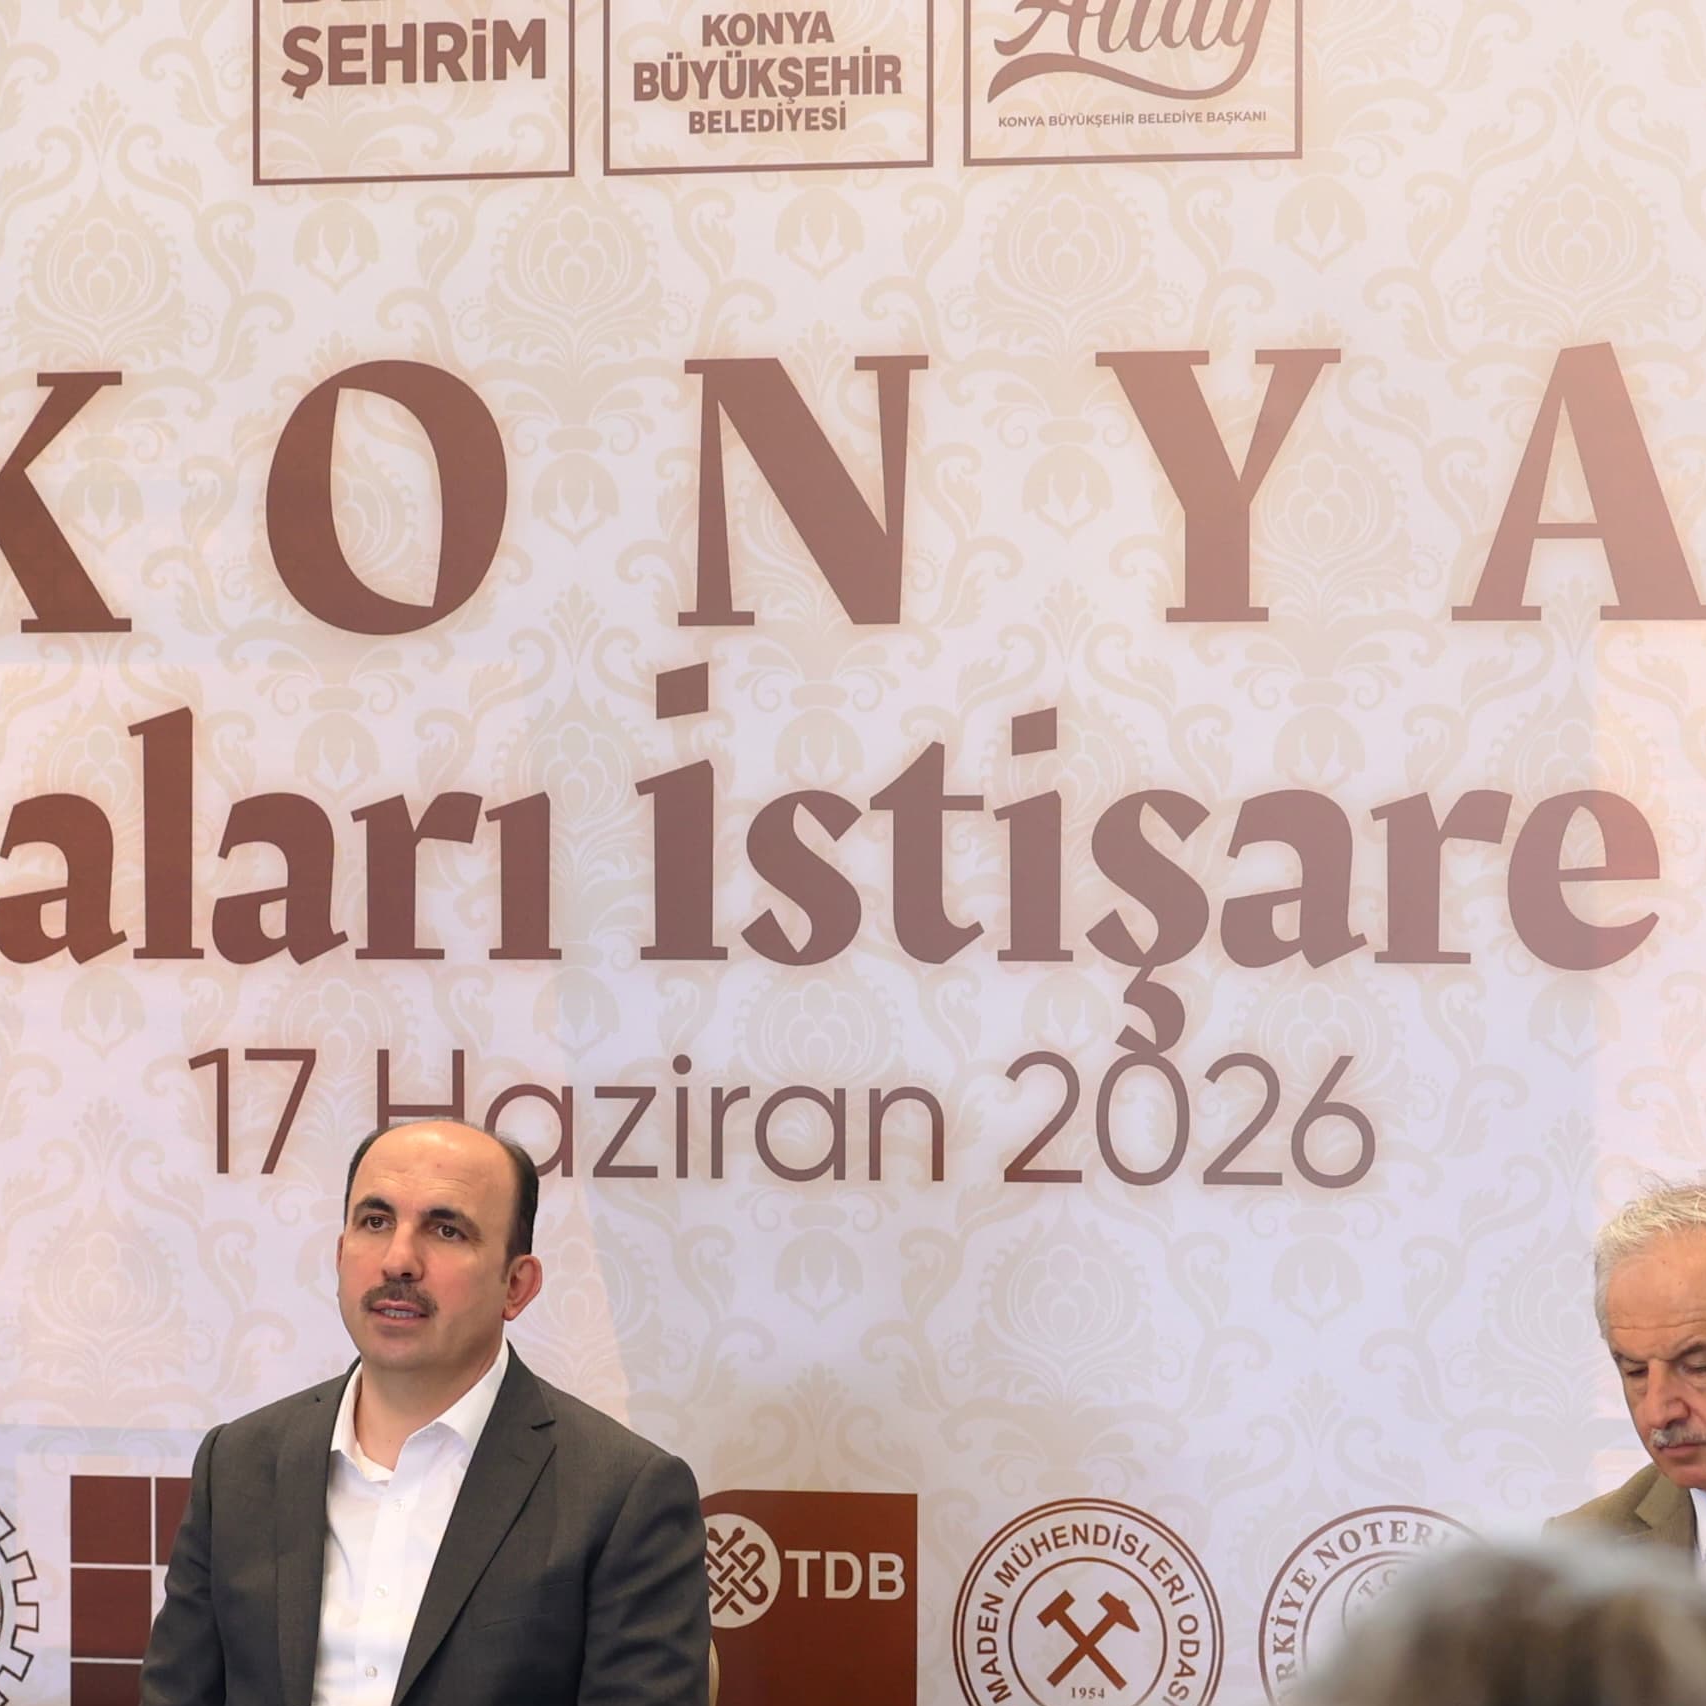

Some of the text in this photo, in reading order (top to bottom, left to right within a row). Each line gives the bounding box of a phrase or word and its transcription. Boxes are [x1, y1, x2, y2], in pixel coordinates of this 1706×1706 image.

[701, 11, 835, 47] KONYA
[633, 46, 902, 104] BÜYÜKŞEHİR
[688, 100, 846, 134] BELEDİYESİ
[998, 110, 1267, 128] KONYA BÜYÜKŞEHİR BELEDİYE BAŞKANI
[634, 661, 1660, 1054] İstişare
[188, 1046, 1377, 1190] 17 Haziran 2026
[784, 1549, 907, 1600] TDB
[993, 1522, 1195, 1607] MÜHENDİSLERİ
[976, 1591, 1013, 1704] MADEN
[1270, 1567, 1318, 1702] RKİYE
[1070, 1687, 1105, 1700] 1954
